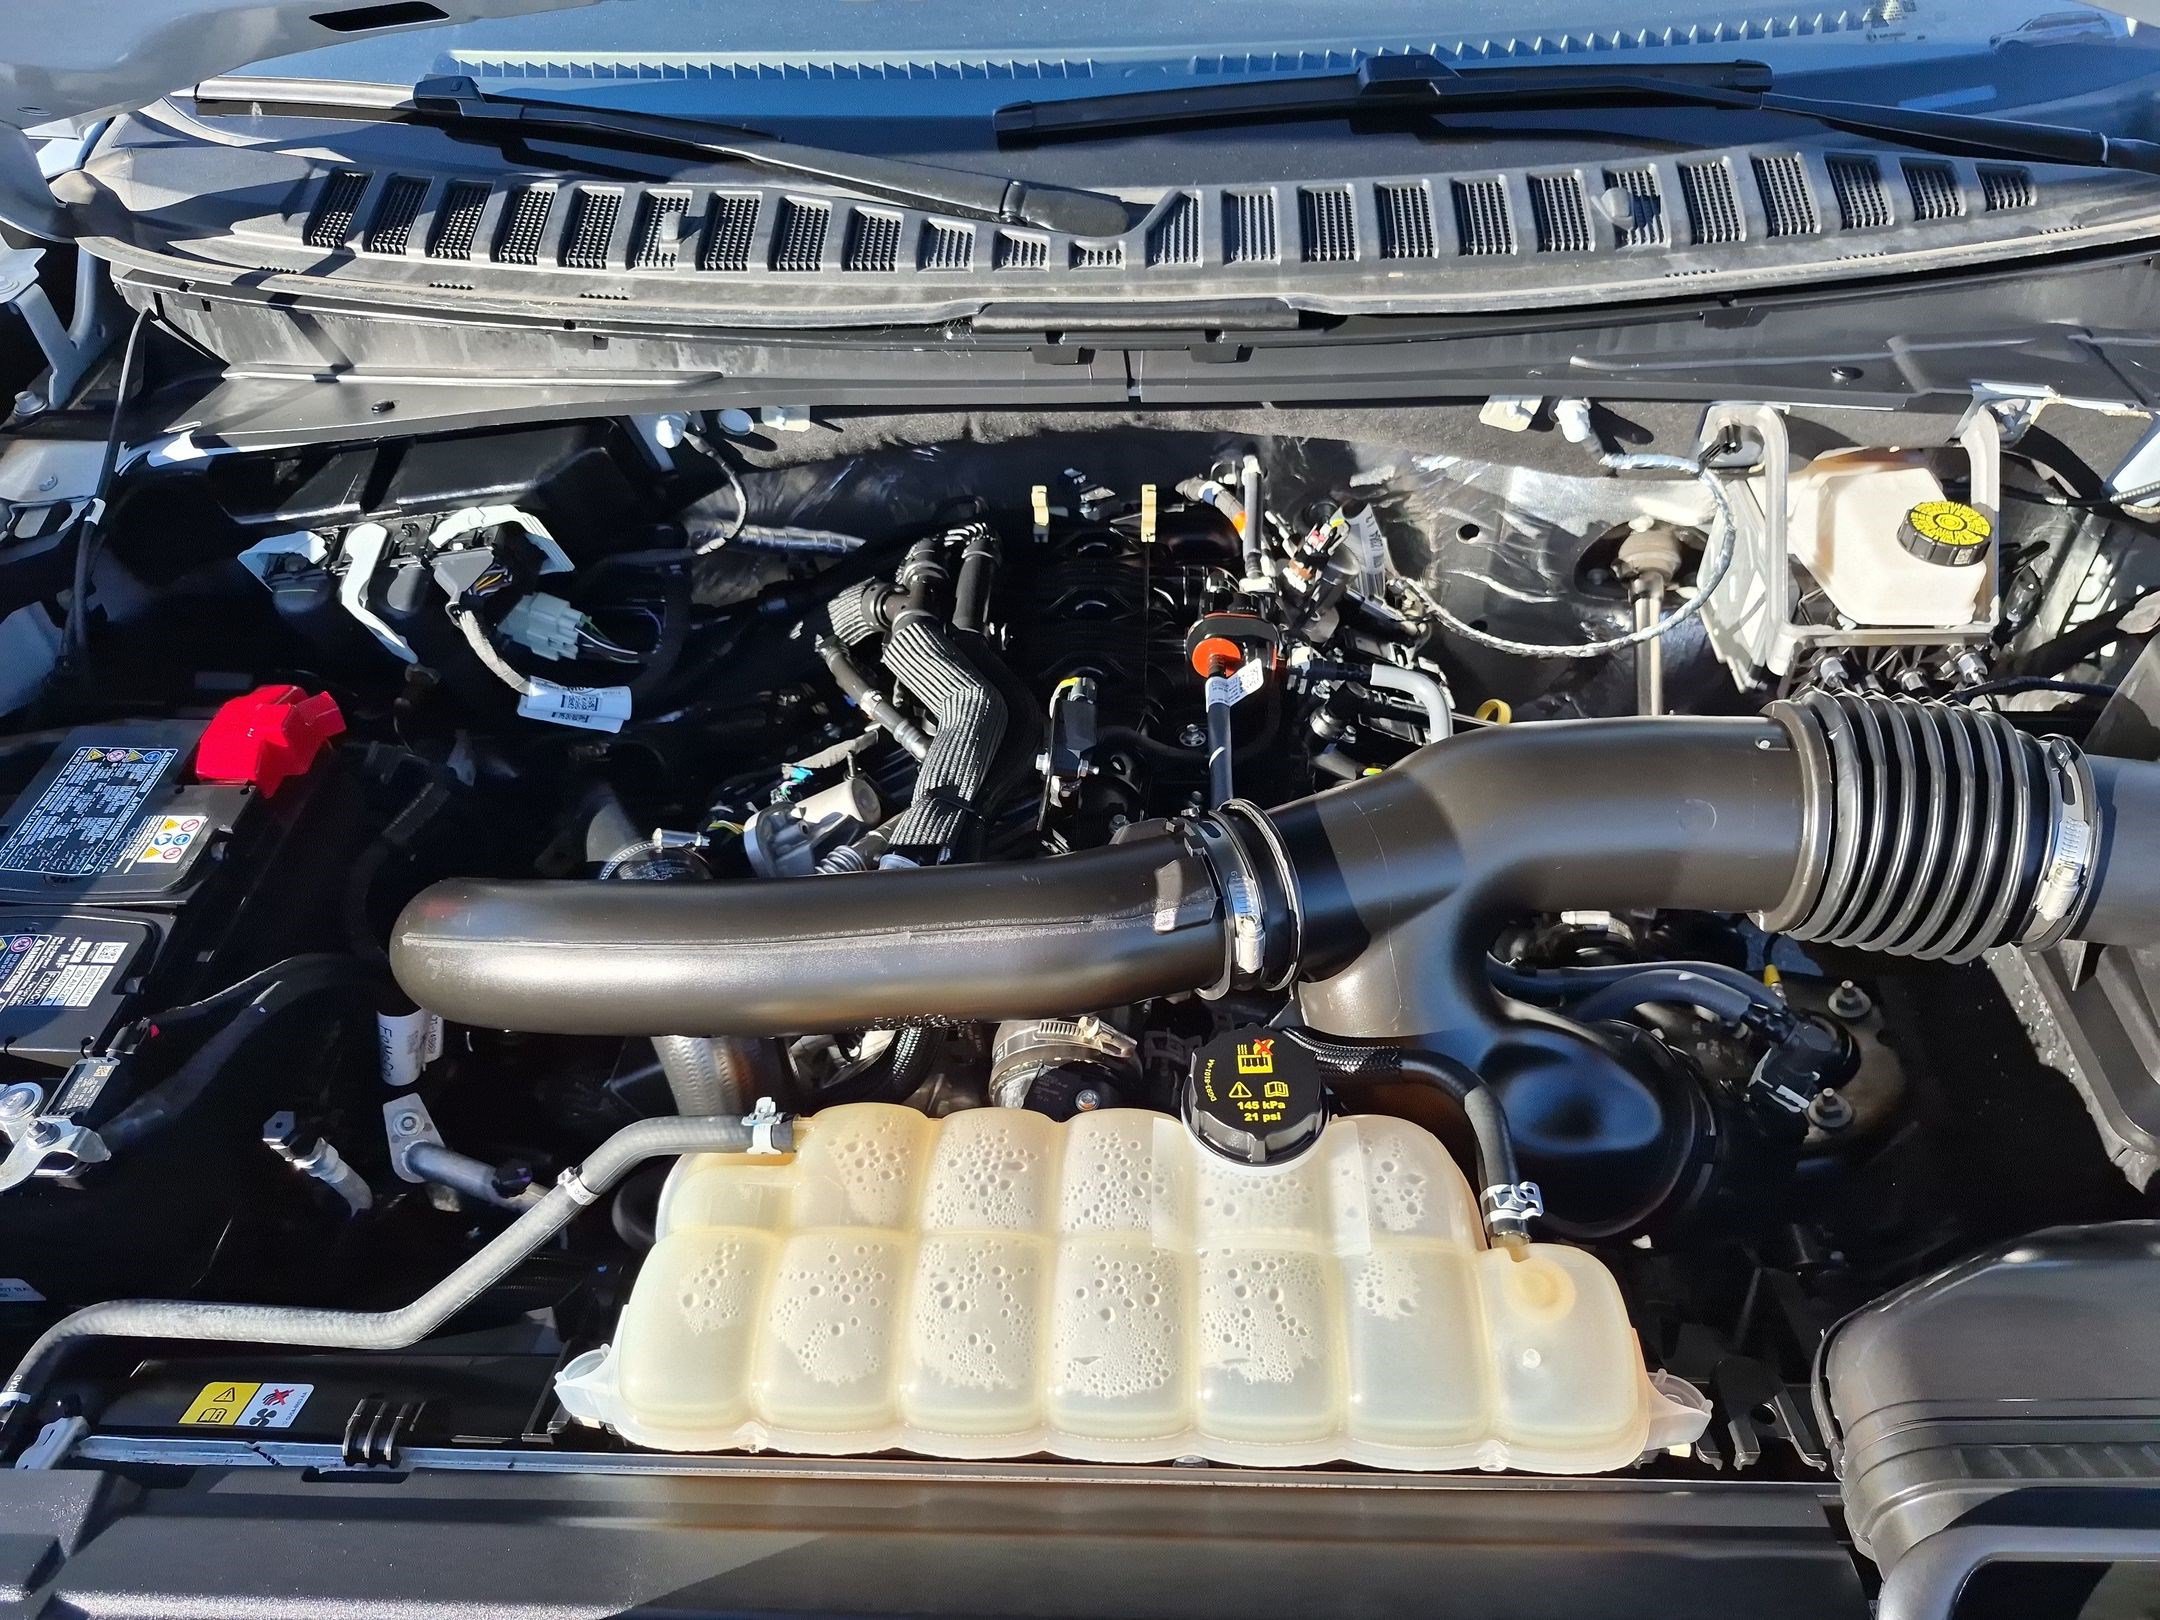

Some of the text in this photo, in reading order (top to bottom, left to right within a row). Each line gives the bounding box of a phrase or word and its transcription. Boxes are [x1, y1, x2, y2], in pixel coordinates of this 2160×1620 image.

[55, 954, 71, 969] MF
[27, 972, 55, 1005] FoMoCo
[1237, 1101, 1286, 1110] 145 kPa
[1244, 1112, 1281, 1123] 21 psi
[8, 1375, 22, 1391] RAD
